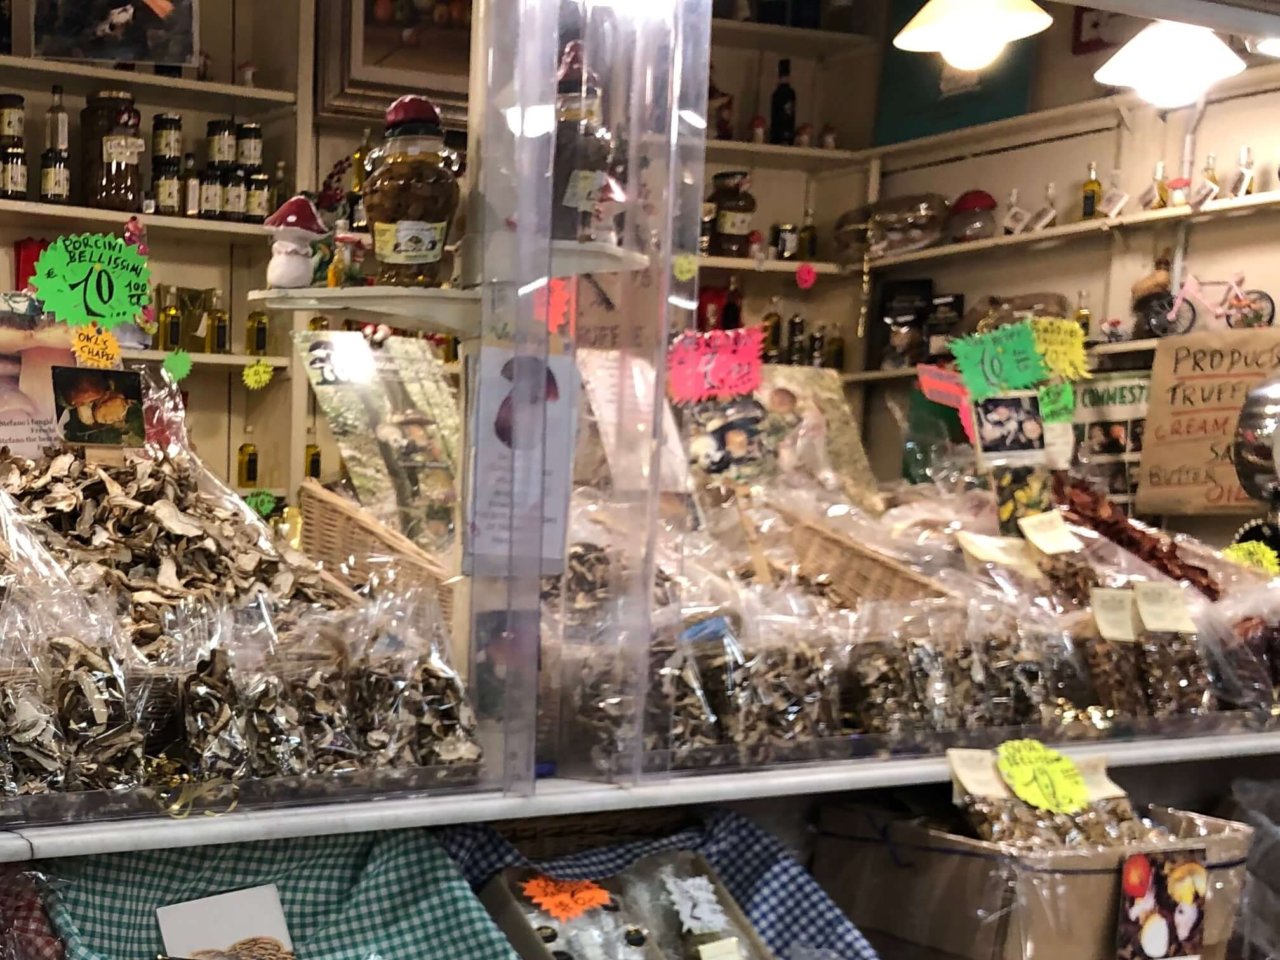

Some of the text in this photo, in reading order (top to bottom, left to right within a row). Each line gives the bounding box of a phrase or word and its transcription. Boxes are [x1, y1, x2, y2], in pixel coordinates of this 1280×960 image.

[62, 237, 123, 254] PORCINI
[68, 251, 144, 277] BELLISSIMI
[125, 281, 148, 293] 100
[1082, 385, 1145, 408] COMMEST
[1168, 383, 1250, 406] TRUFF
[1154, 416, 1230, 441] CREAM
